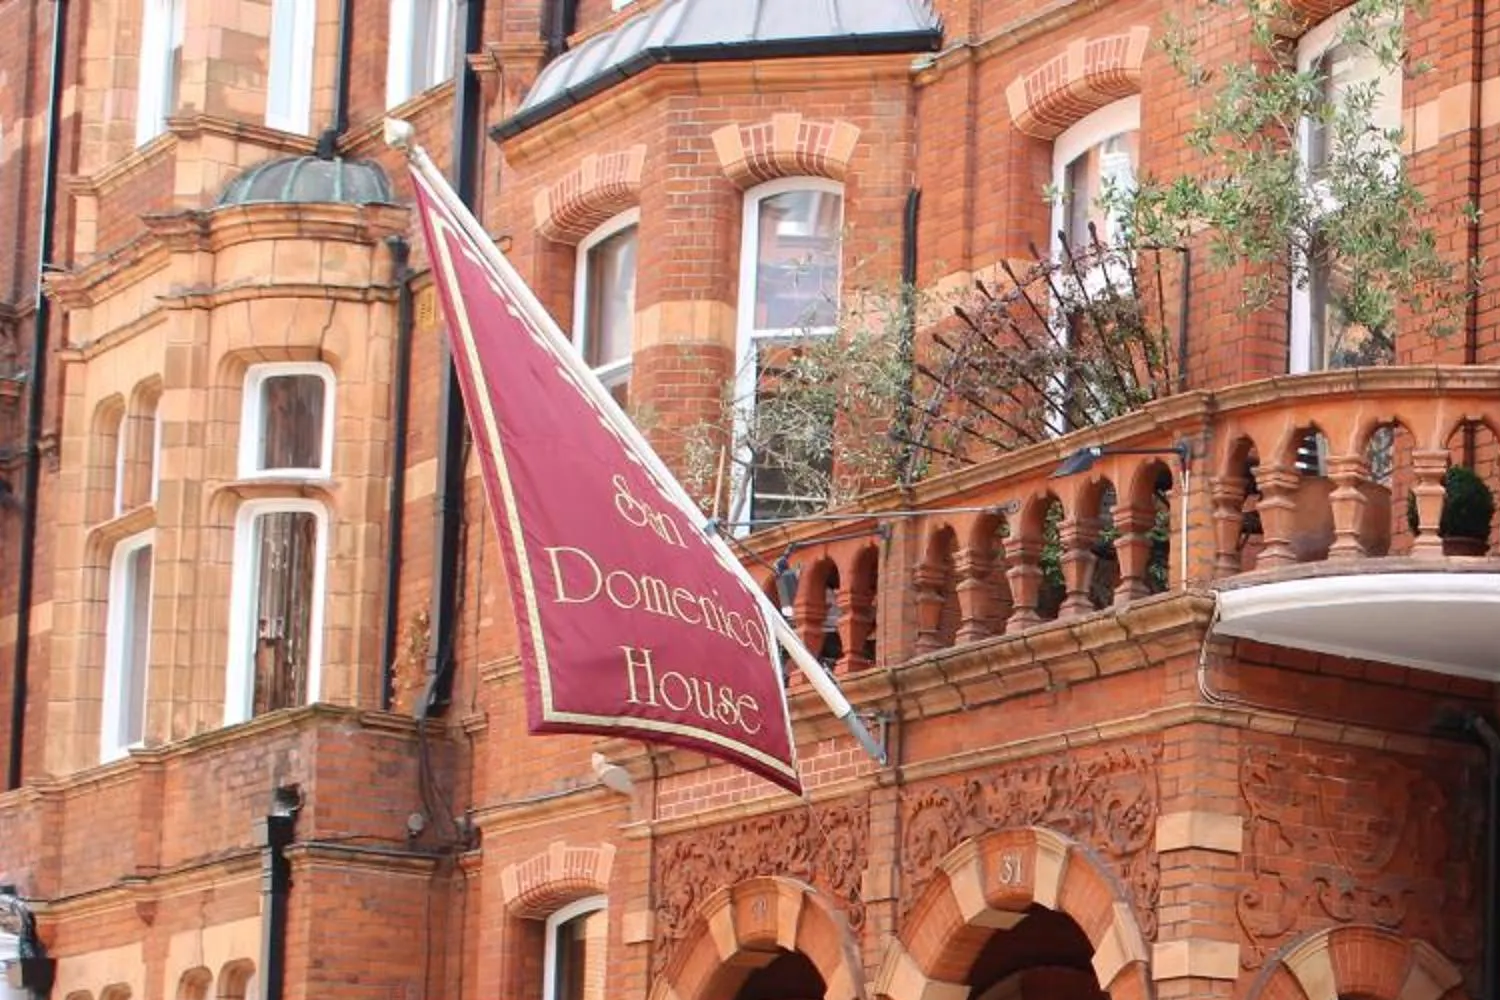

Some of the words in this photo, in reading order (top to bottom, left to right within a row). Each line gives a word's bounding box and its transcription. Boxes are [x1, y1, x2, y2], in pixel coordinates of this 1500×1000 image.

[611, 474, 689, 549] San
[543, 546, 766, 656] Domenico
[619, 645, 761, 735] House
